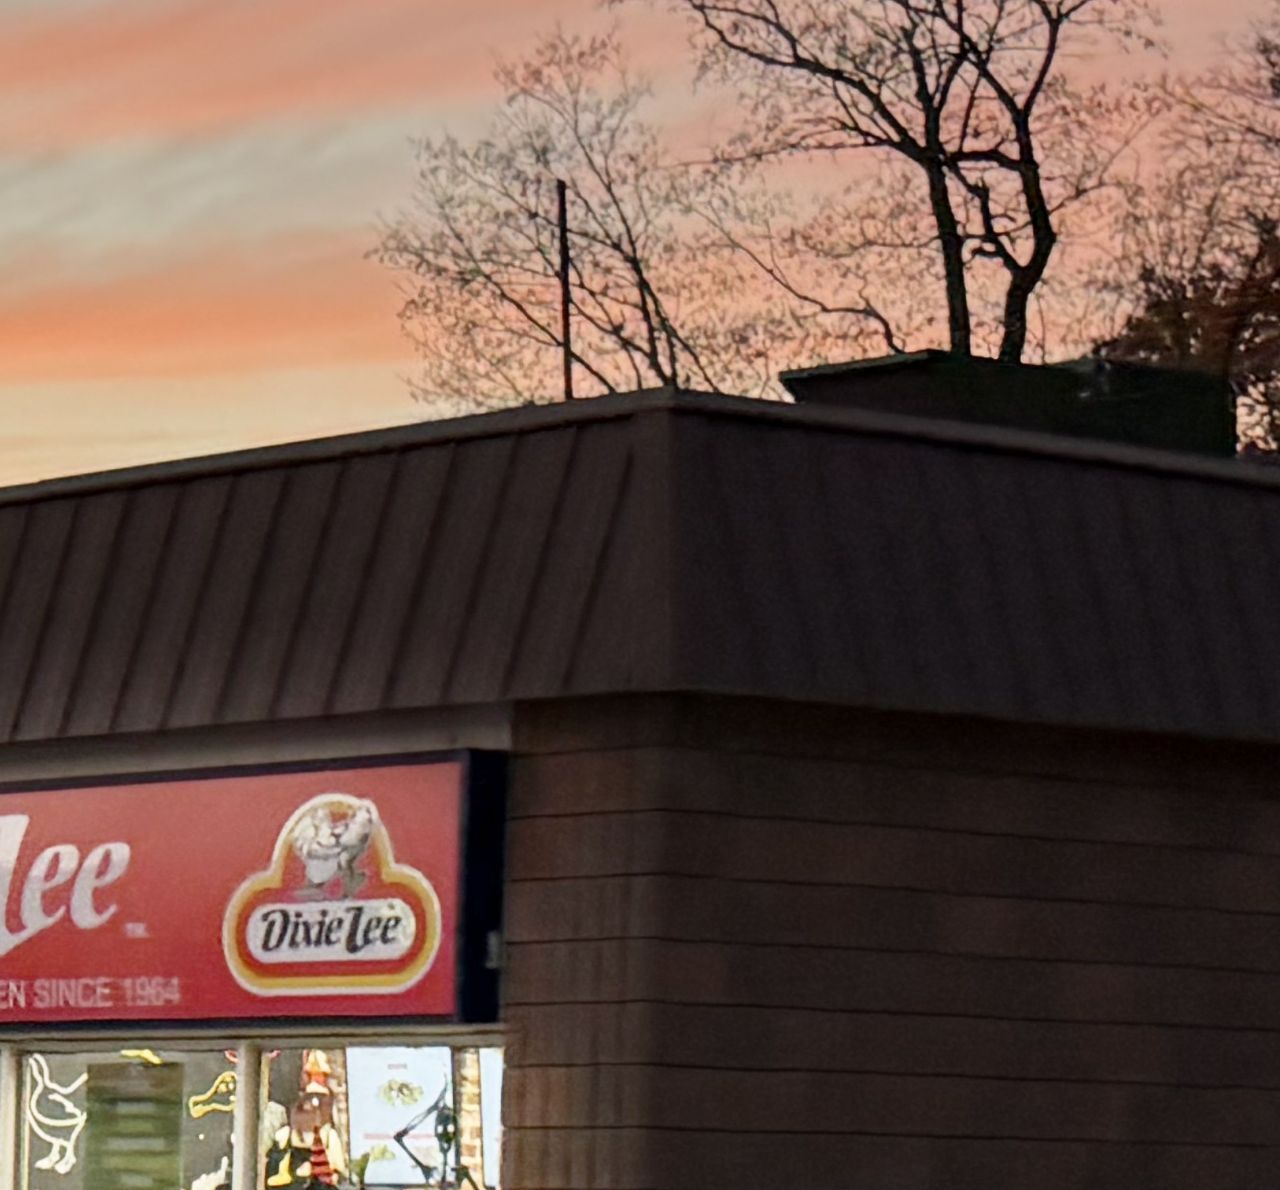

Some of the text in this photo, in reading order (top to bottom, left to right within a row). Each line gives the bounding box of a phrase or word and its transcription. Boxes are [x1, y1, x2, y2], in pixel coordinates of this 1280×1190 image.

[261, 903, 402, 954] Dixie Lee
[33, 978, 114, 1008] SINCE
